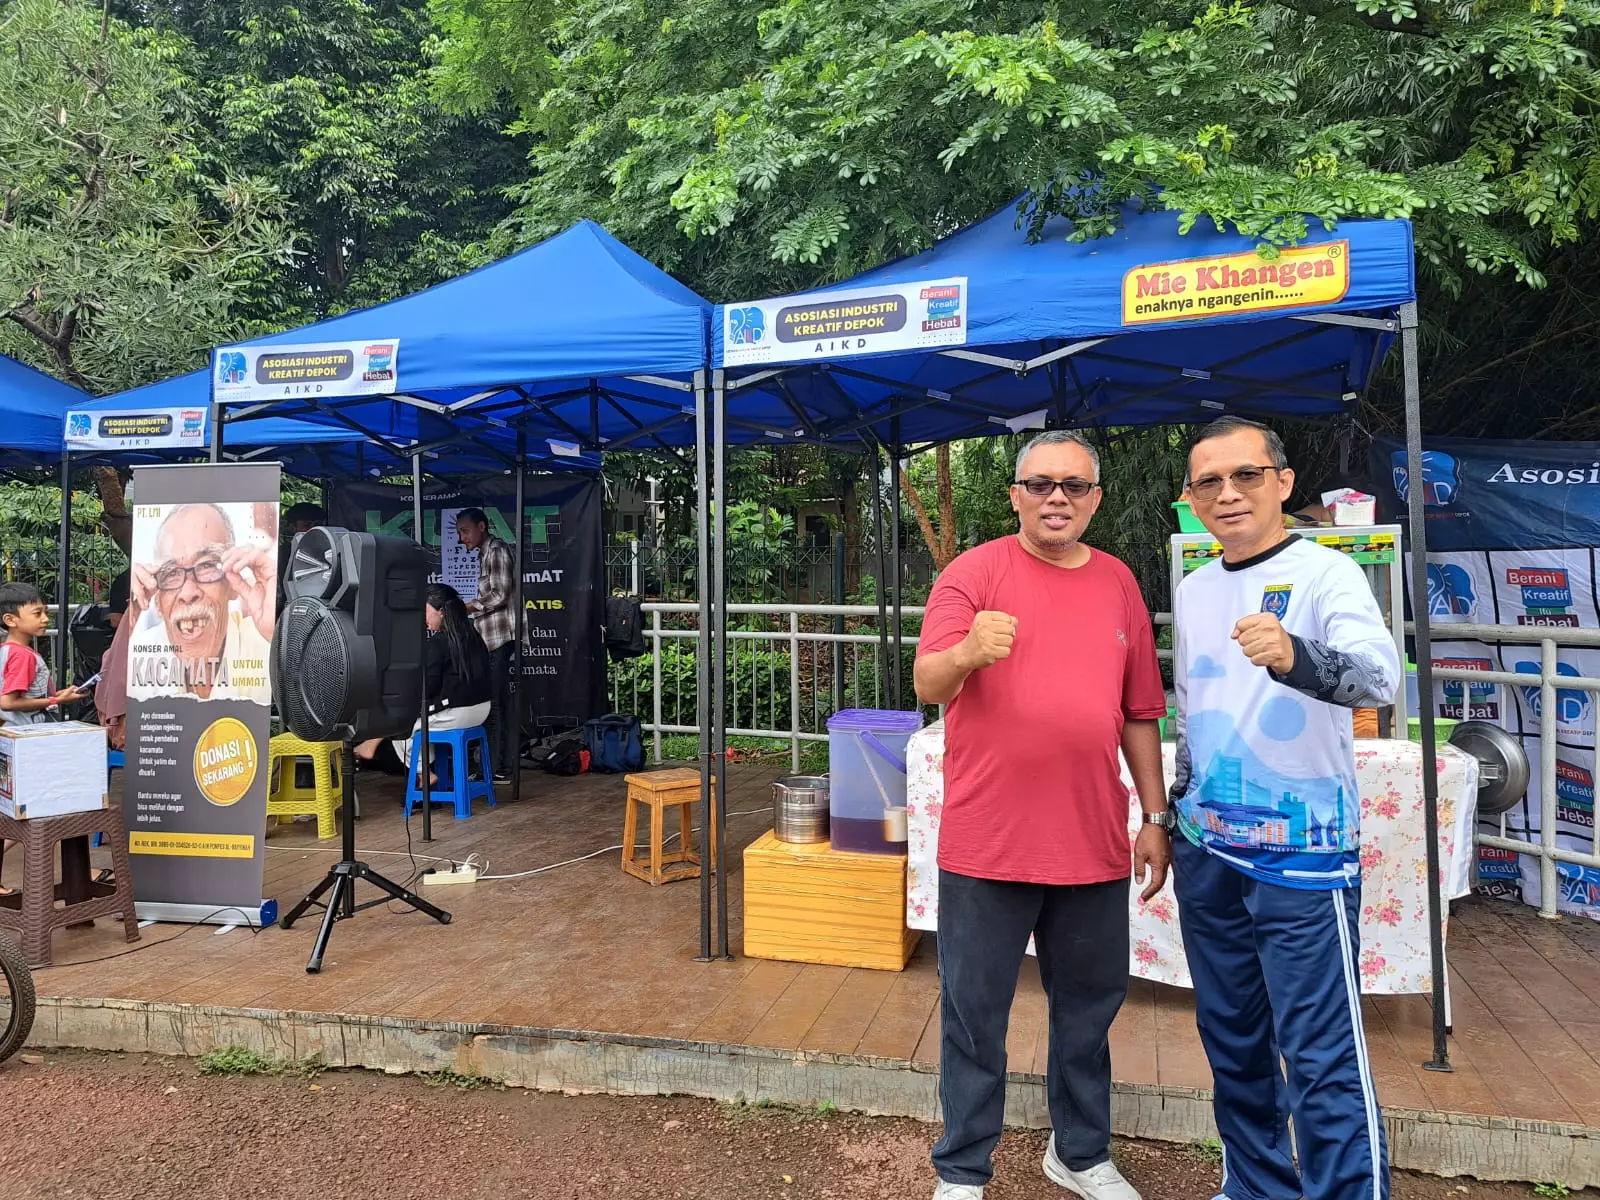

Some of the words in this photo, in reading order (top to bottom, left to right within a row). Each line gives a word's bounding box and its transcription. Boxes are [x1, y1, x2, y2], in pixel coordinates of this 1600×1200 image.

[1135, 271, 1187, 299] Mie
[1195, 258, 1336, 291] Khangen
[921, 288, 953, 299] Berani
[928, 299, 959, 310] Kreatif
[1135, 297, 1194, 315] enaknya
[784, 308, 840, 324] ASOSIASI
[841, 301, 898, 318] INDUSTRI
[793, 322, 842, 337] KREATIF
[844, 316, 885, 331] DEPOK
[925, 319, 958, 331] Hebat
[365, 347, 389, 356] Berani
[262, 356, 304, 369] ASOSIASI
[304, 354, 347, 367] INDUSTRI
[370, 356, 391, 365] Kreatif
[268, 368, 305, 380] KREATIF
[306, 367, 337, 378] DEPOK
[365, 371, 392, 381] Hebat
[103, 418, 136, 428] ASOSIASI
[136, 417, 169, 426] INDUSTRI
[108, 427, 137, 435] KREATIF
[137, 425, 161, 434] DEPOK
[1508, 571, 1556, 585] Berani
[1523, 588, 1570, 602] Kreatif
[1524, 614, 1573, 628] Hebat
[532, 625, 558, 639] dan
[133, 644, 162, 654] KONSER
[163, 644, 184, 653] AMAL
[521, 646, 562, 658] ekimu
[232, 659, 264, 670] UNTUK
[131, 656, 230, 688] KACAMATA
[232, 676, 268, 688] UMMAT
[200, 739, 241, 769] DONASI
[202, 761, 245, 787] SEKARANG
[1556, 767, 1585, 781] erani
[1558, 779, 1594, 798] Kreati
[1556, 807, 1594, 827] Heba
[1480, 847, 1508, 858] rani
